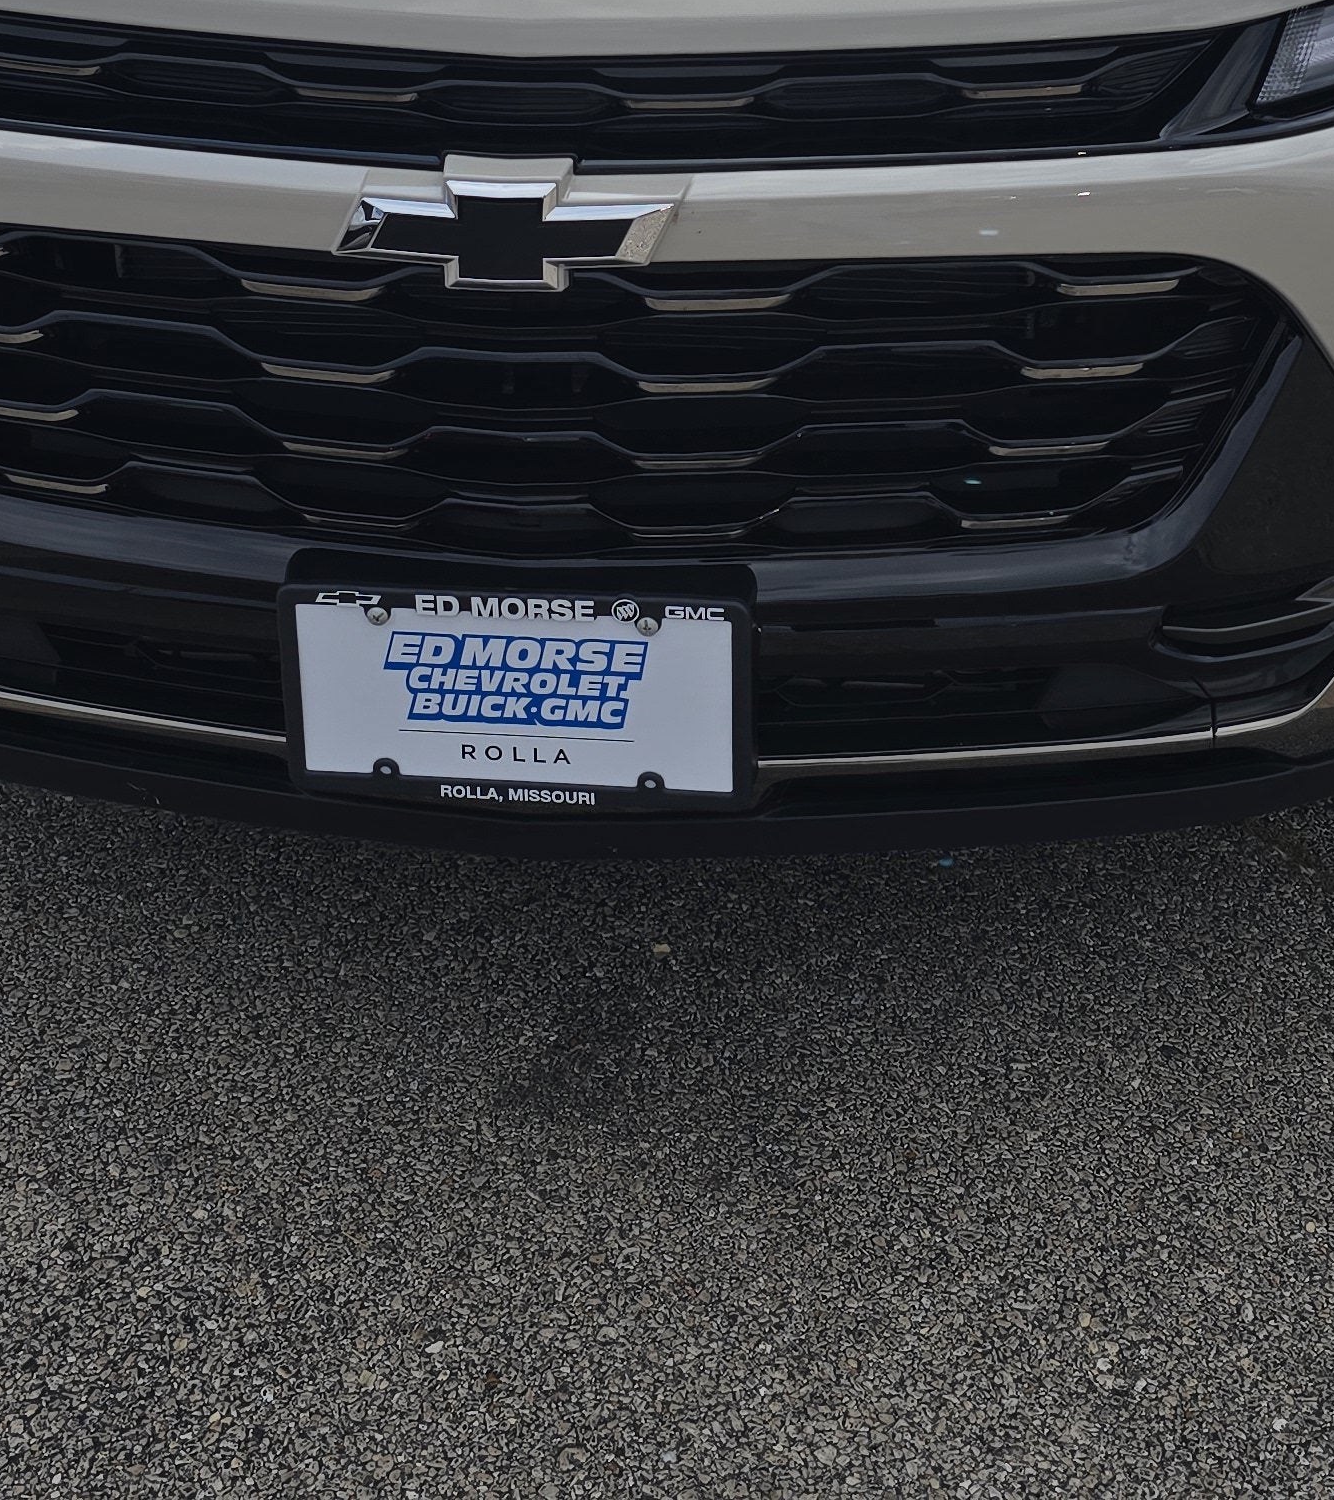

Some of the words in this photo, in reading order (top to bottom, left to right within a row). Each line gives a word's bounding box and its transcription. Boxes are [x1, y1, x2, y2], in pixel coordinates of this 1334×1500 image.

[414, 594, 460, 617] ED
[470, 596, 596, 623] MORSE
[664, 604, 726, 622] GMC
[386, 633, 457, 666] ED
[459, 636, 646, 673] MORSE
[408, 666, 627, 698] CHEVROLET
[460, 743, 572, 766] ROLLA
[439, 784, 504, 803] ROLLA,
[507, 787, 596, 806] MISSOURI
